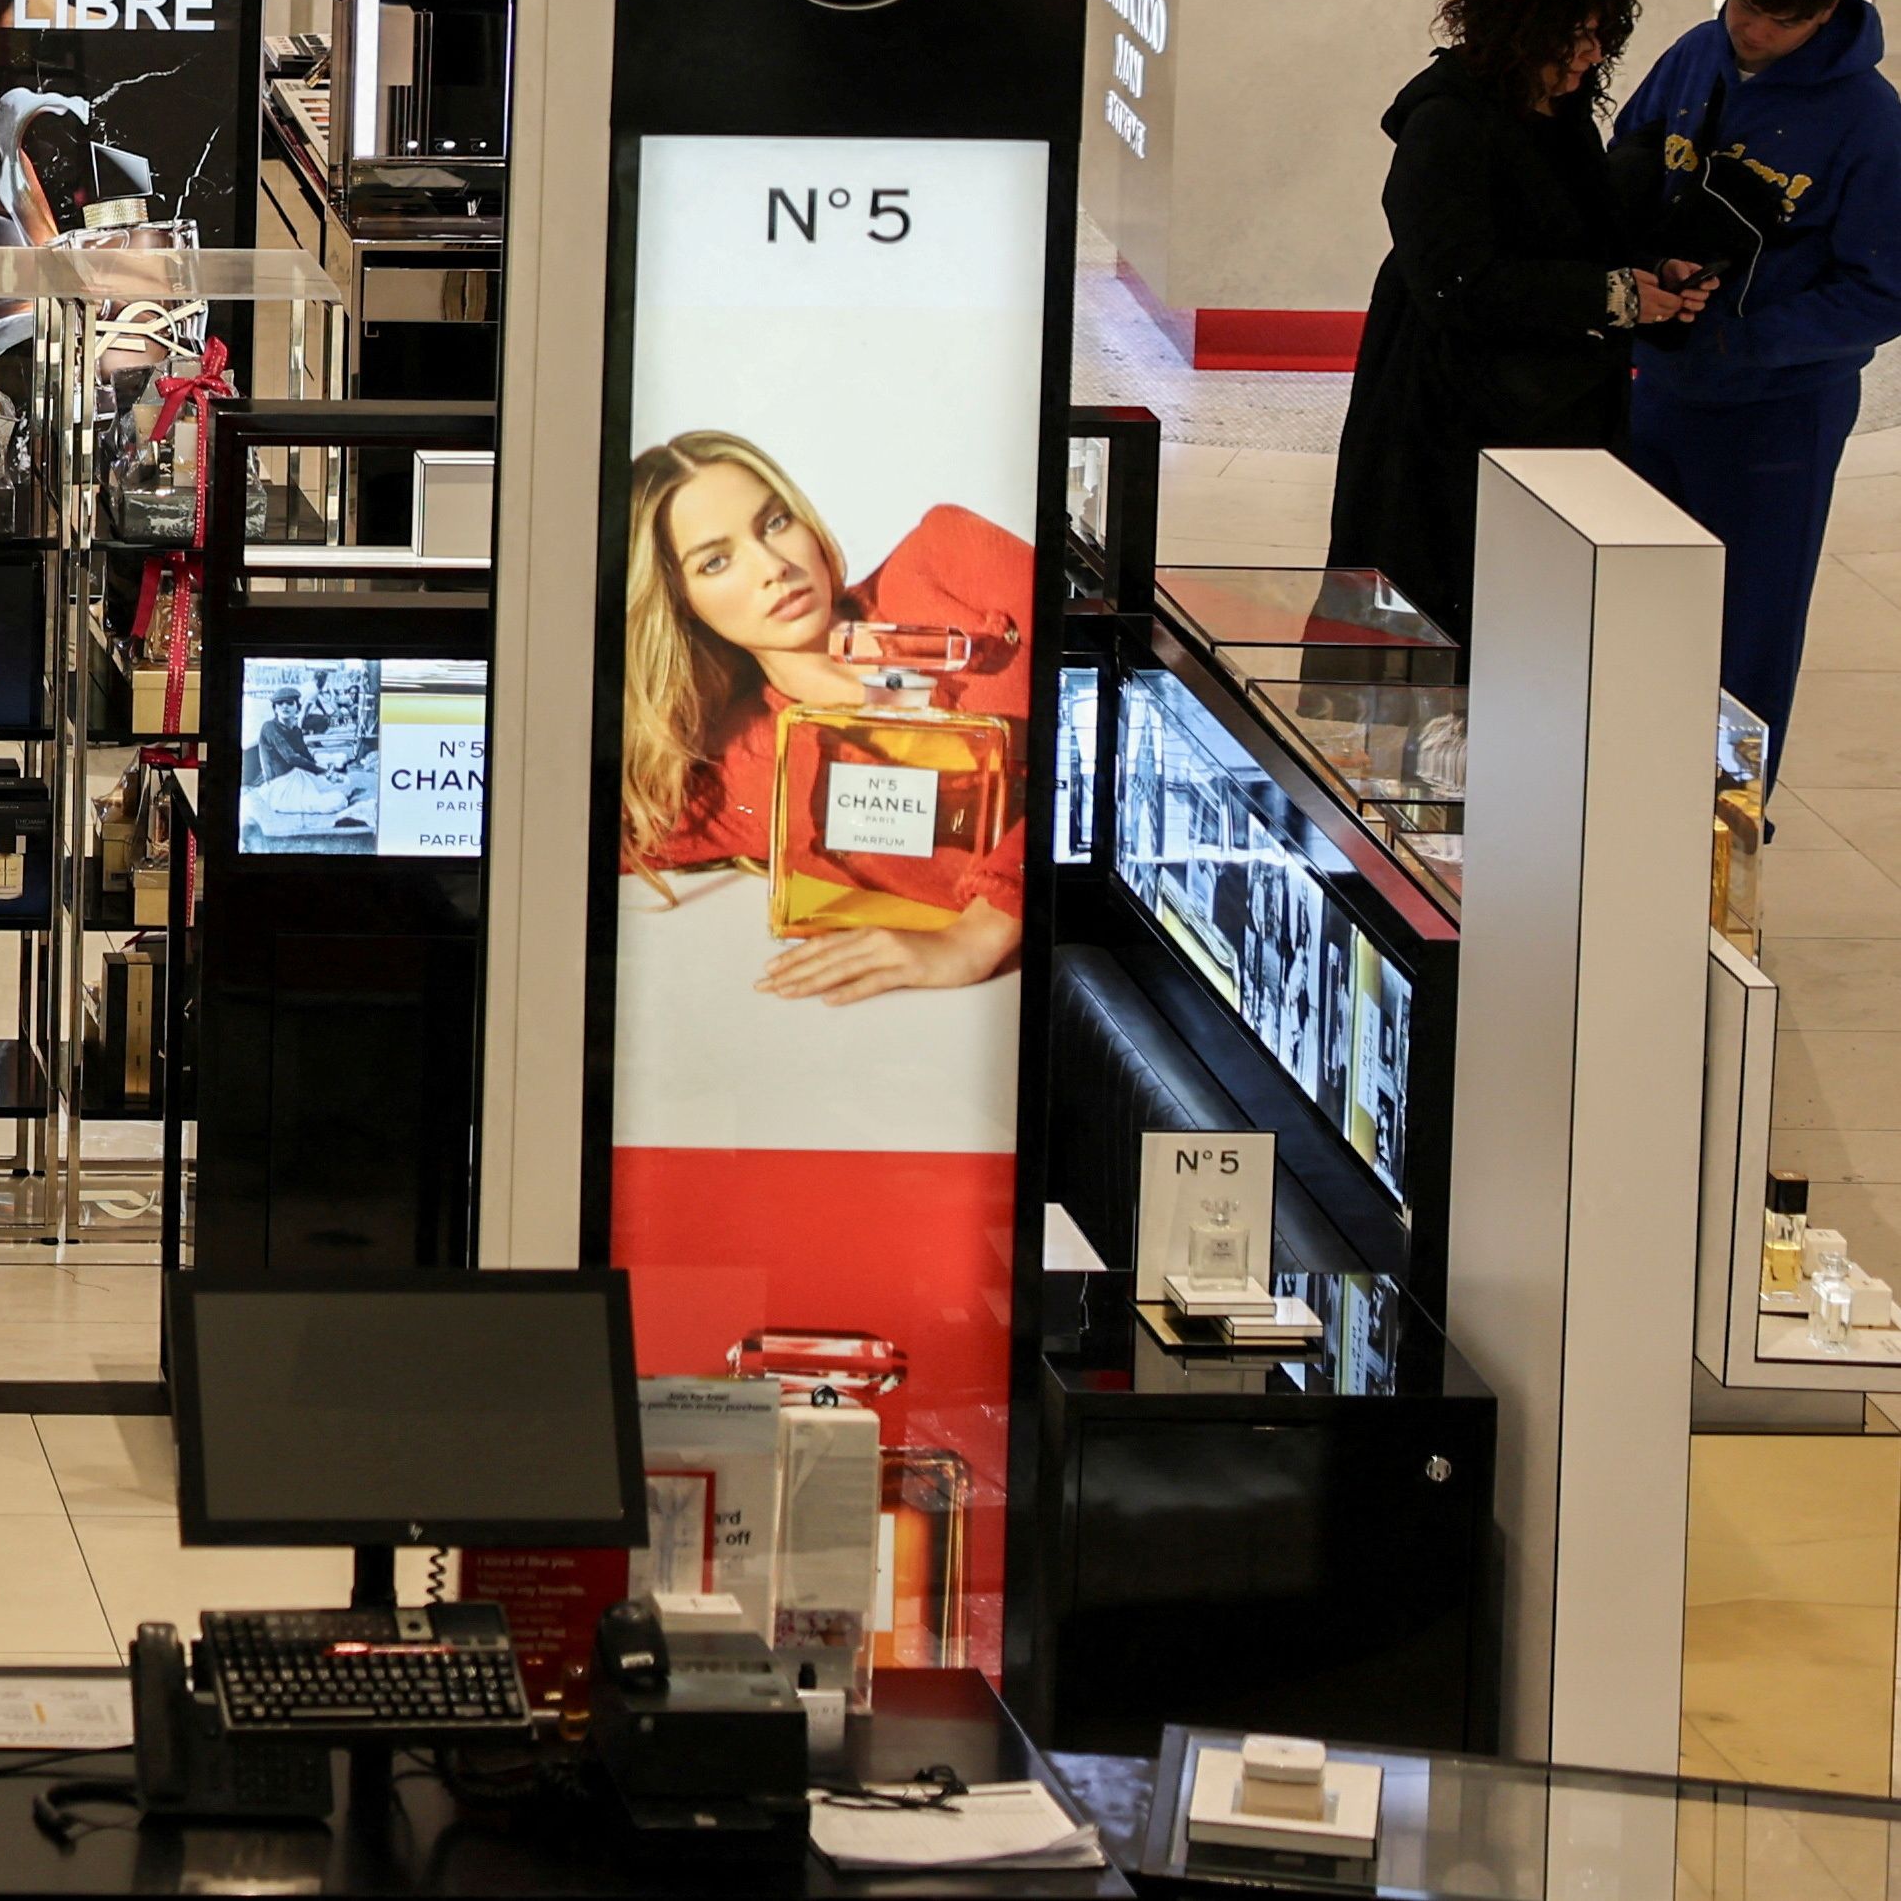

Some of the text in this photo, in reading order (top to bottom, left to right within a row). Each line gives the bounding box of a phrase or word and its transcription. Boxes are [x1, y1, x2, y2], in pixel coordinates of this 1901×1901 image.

[1112, 33, 1146, 99] MAN
[836, 793, 929, 815] CHANEL
[864, 815, 896, 825] PARIS
[853, 834, 906, 847] PARFUM
[725, 1530, 751, 1547] off
